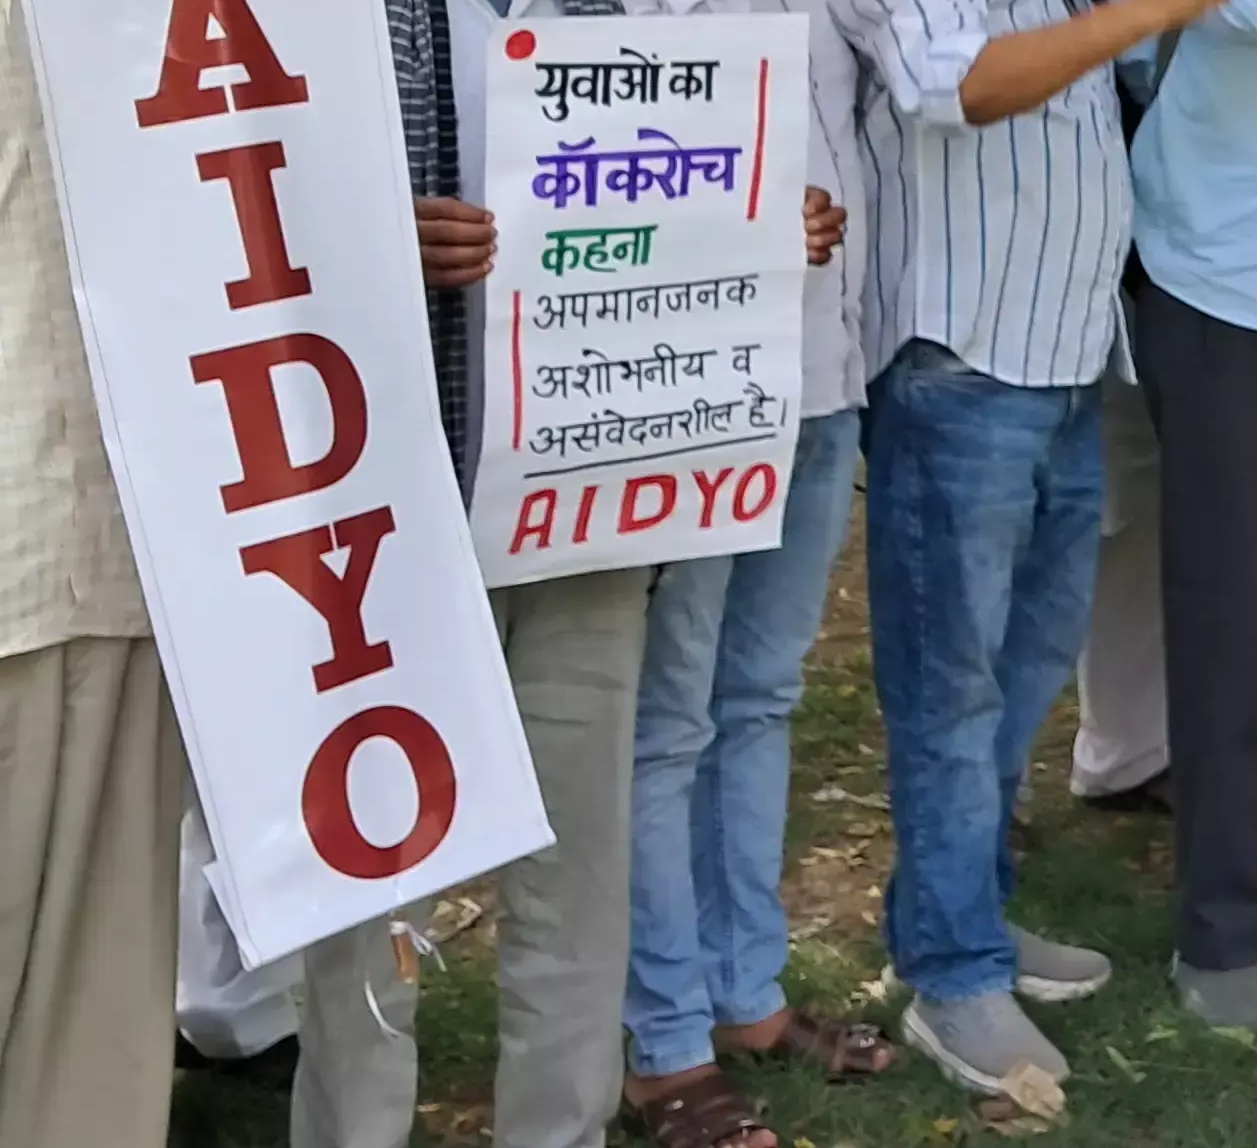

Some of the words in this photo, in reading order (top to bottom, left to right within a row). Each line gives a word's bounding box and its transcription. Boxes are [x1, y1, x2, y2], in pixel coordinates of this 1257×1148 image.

[535, 48, 662, 121] युवाओं
[668, 61, 719, 102] का
[531, 129, 742, 208] कॉकरोच
[541, 225, 658, 276] कहना
[533, 274, 759, 329] अपमानजनक
[532, 343, 717, 399] अशोभनीय
[732, 344, 760, 377] व
[529, 399, 744, 459] असंवेदनशील
[508, 461, 777, 555] AIDYO
